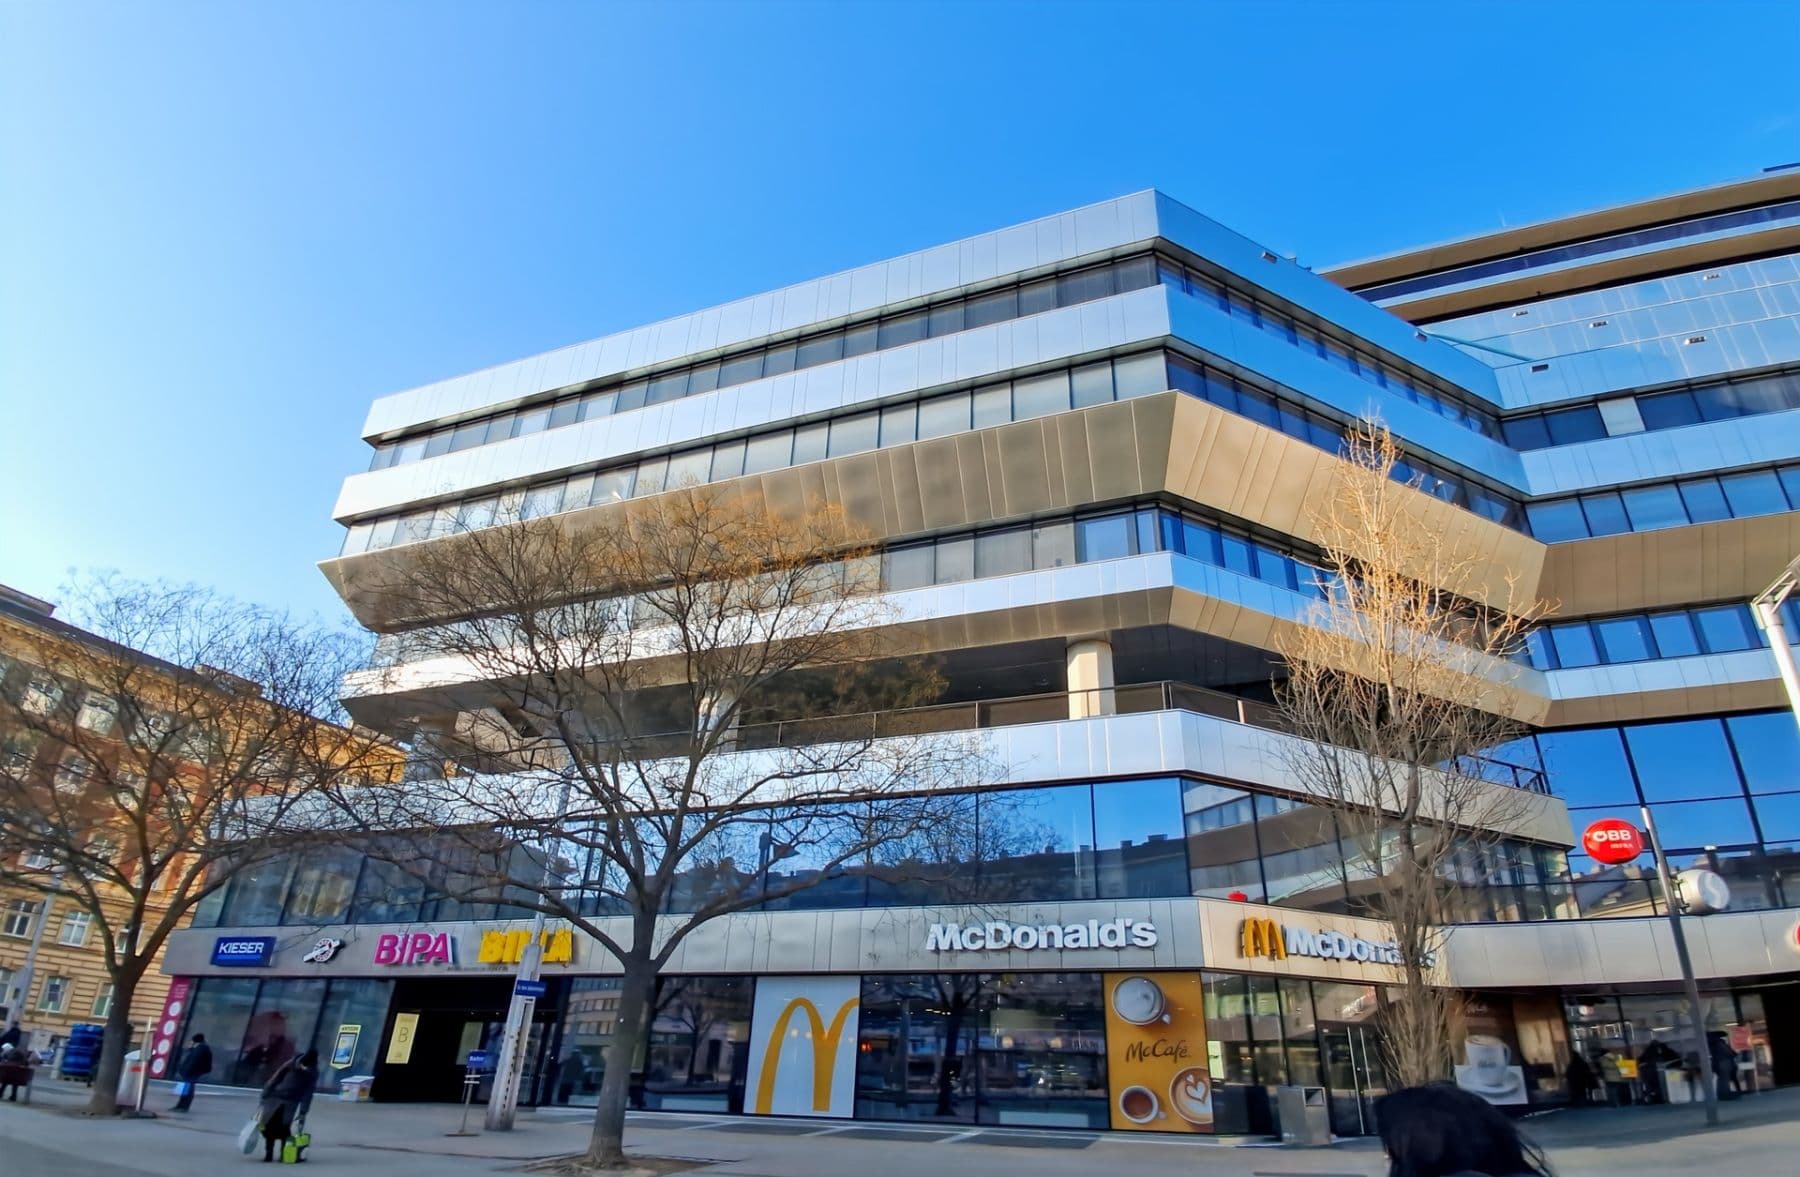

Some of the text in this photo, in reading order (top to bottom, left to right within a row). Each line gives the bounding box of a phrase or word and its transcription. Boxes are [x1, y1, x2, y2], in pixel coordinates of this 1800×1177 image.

[218, 942, 264, 954] KIESER
[374, 932, 453, 964] BIPA
[926, 918, 1158, 950] McDonald's
